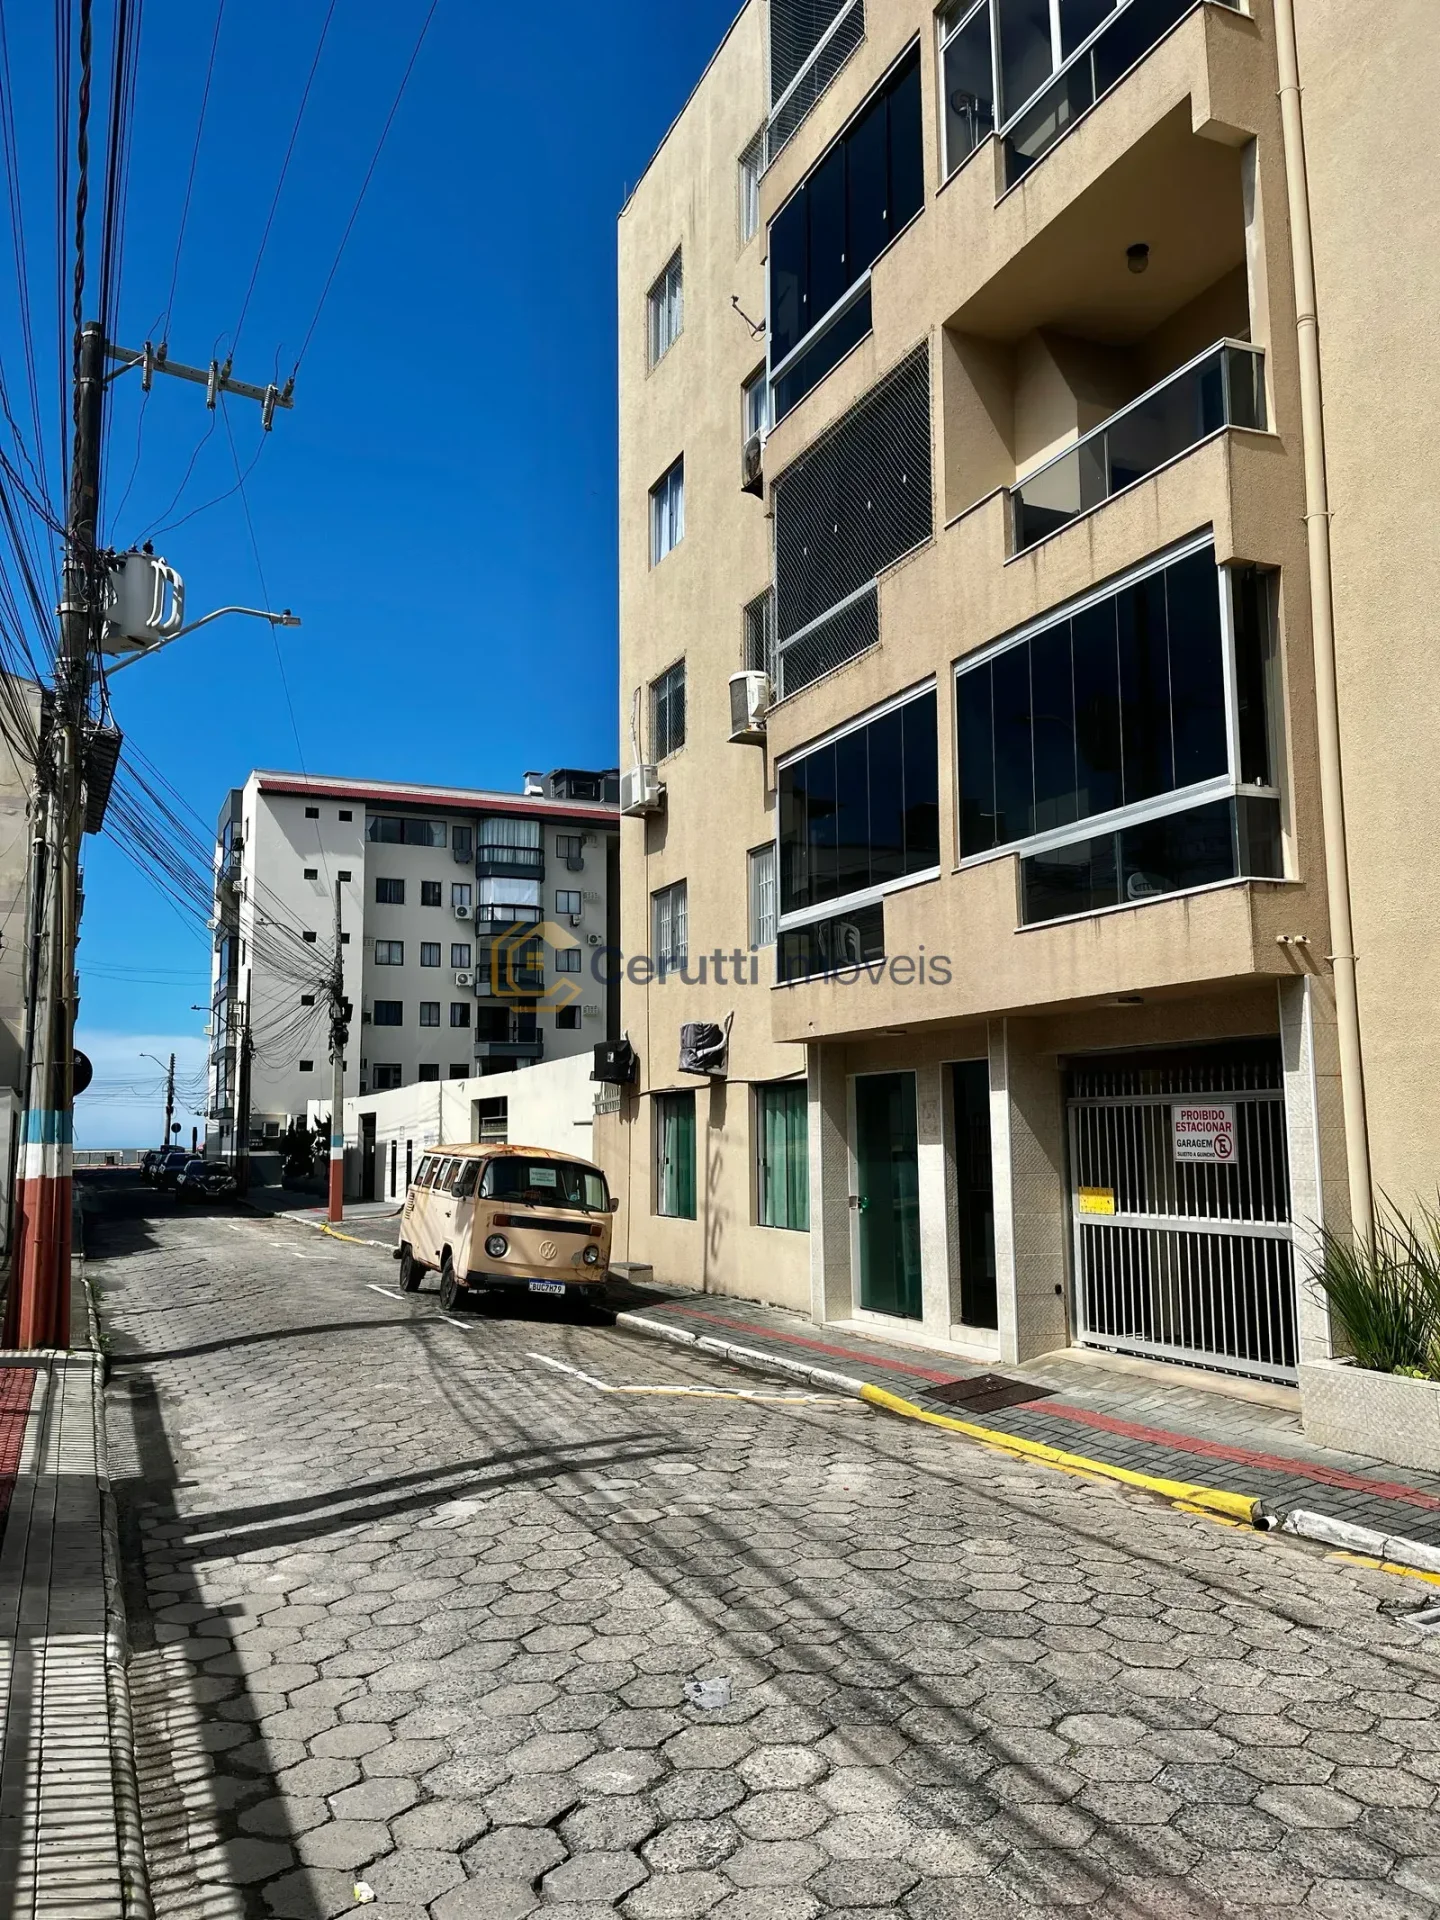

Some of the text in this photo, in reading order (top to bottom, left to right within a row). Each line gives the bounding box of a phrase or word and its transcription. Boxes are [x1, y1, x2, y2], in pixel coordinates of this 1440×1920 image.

[1181, 1110, 1225, 1120] PROIBIDO
[1175, 1122, 1232, 1132] ESTACIONAR
[1176, 1139, 1213, 1148] GARAGEM
